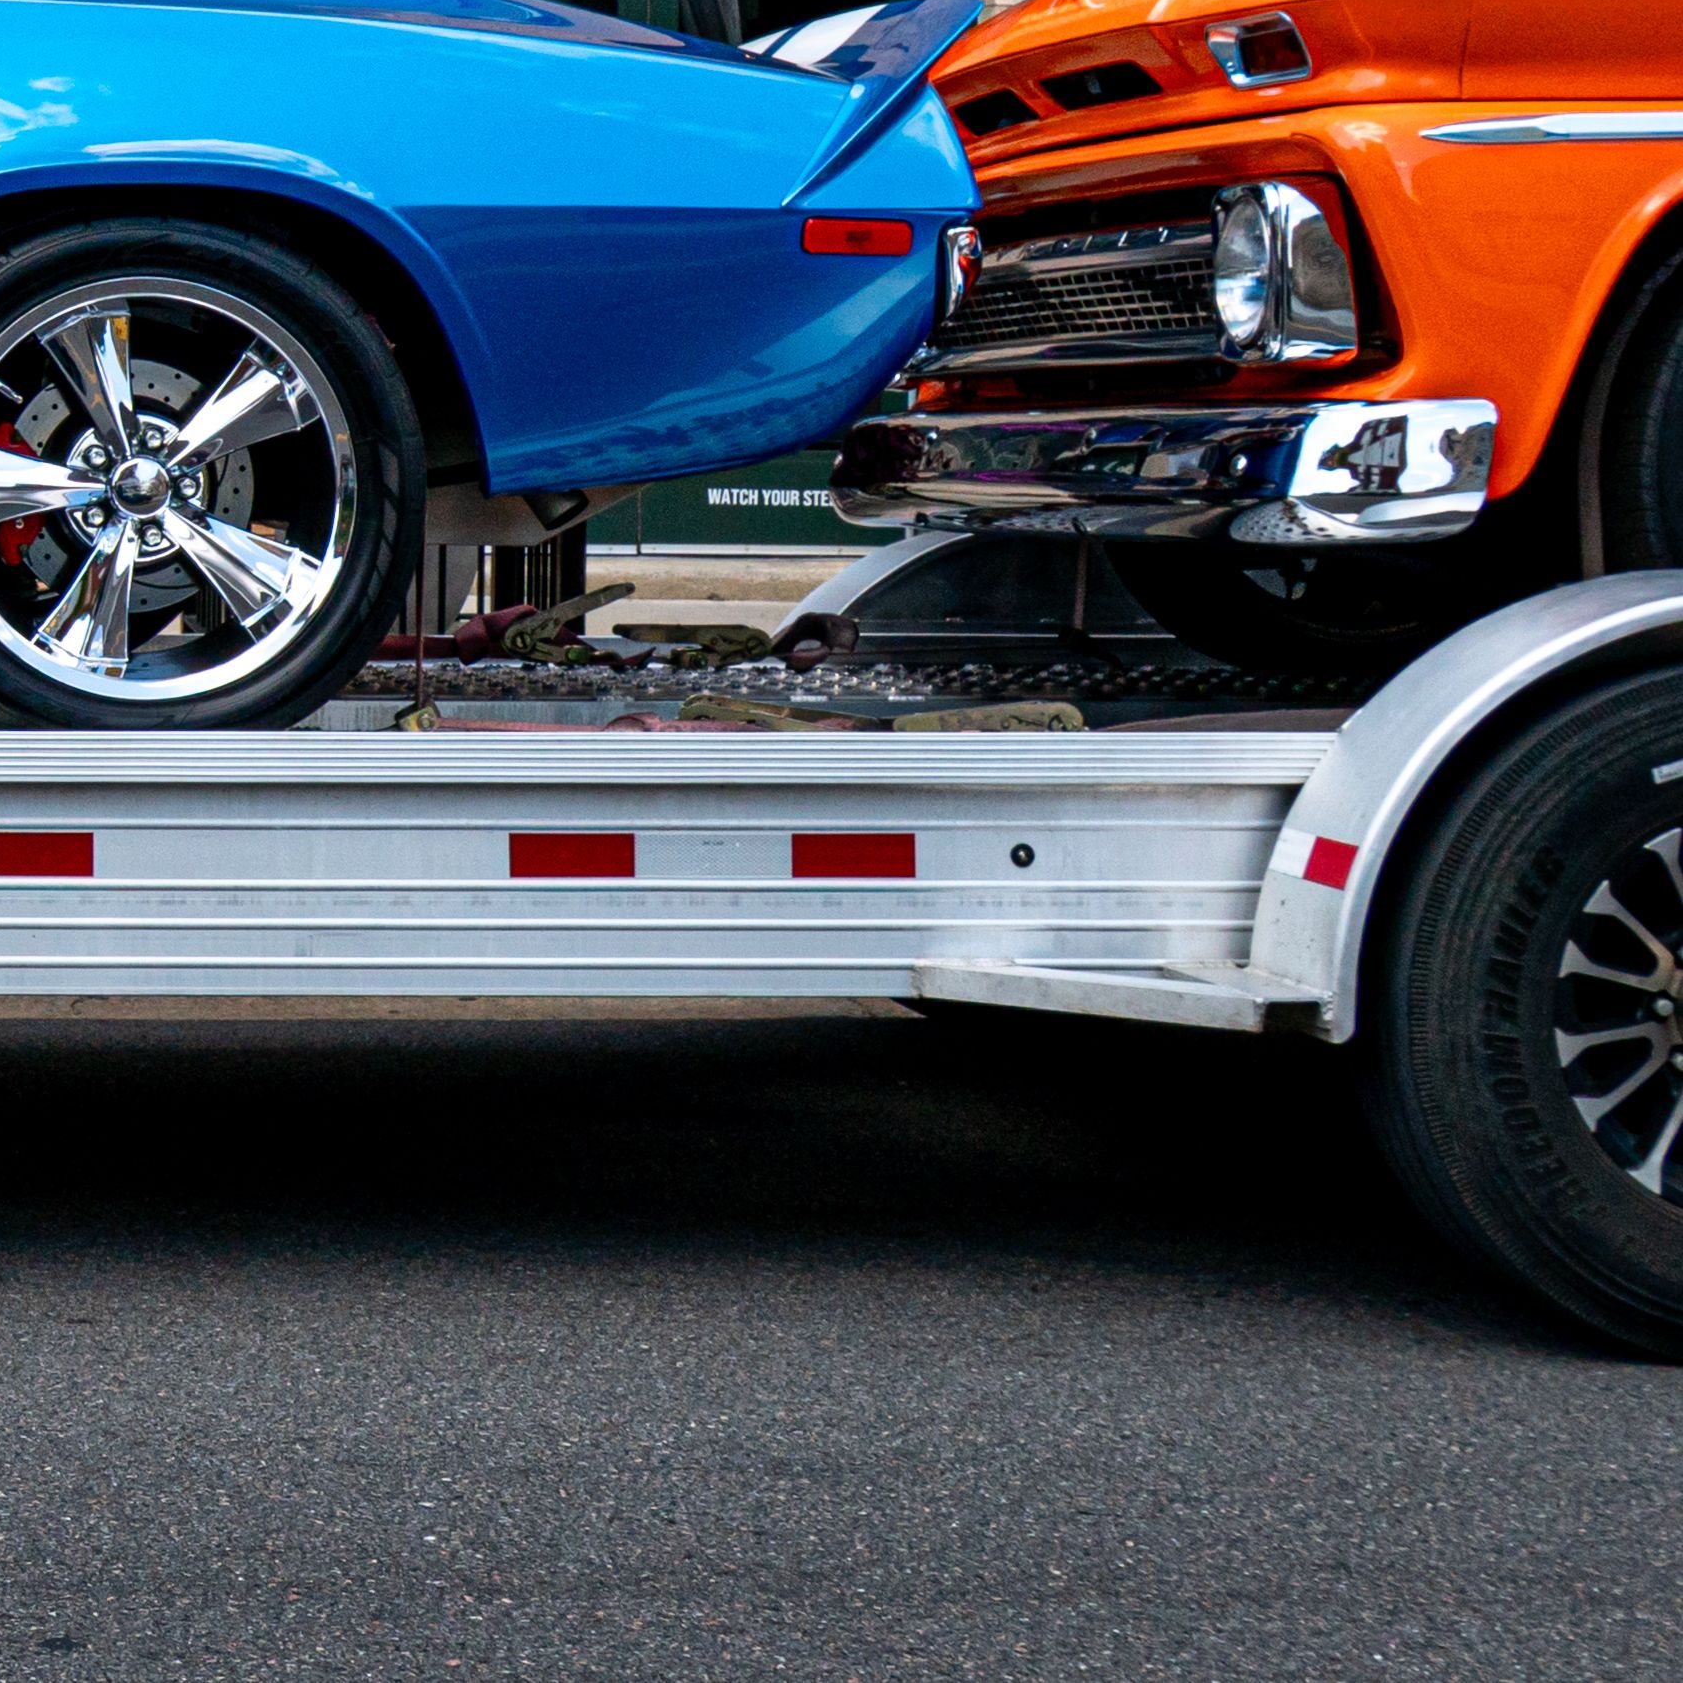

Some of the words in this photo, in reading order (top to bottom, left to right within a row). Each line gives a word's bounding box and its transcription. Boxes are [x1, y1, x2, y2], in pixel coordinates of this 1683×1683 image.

[707, 488, 759, 506] WATCH
[761, 489, 800, 507] YOUR
[802, 490, 835, 508] STE
